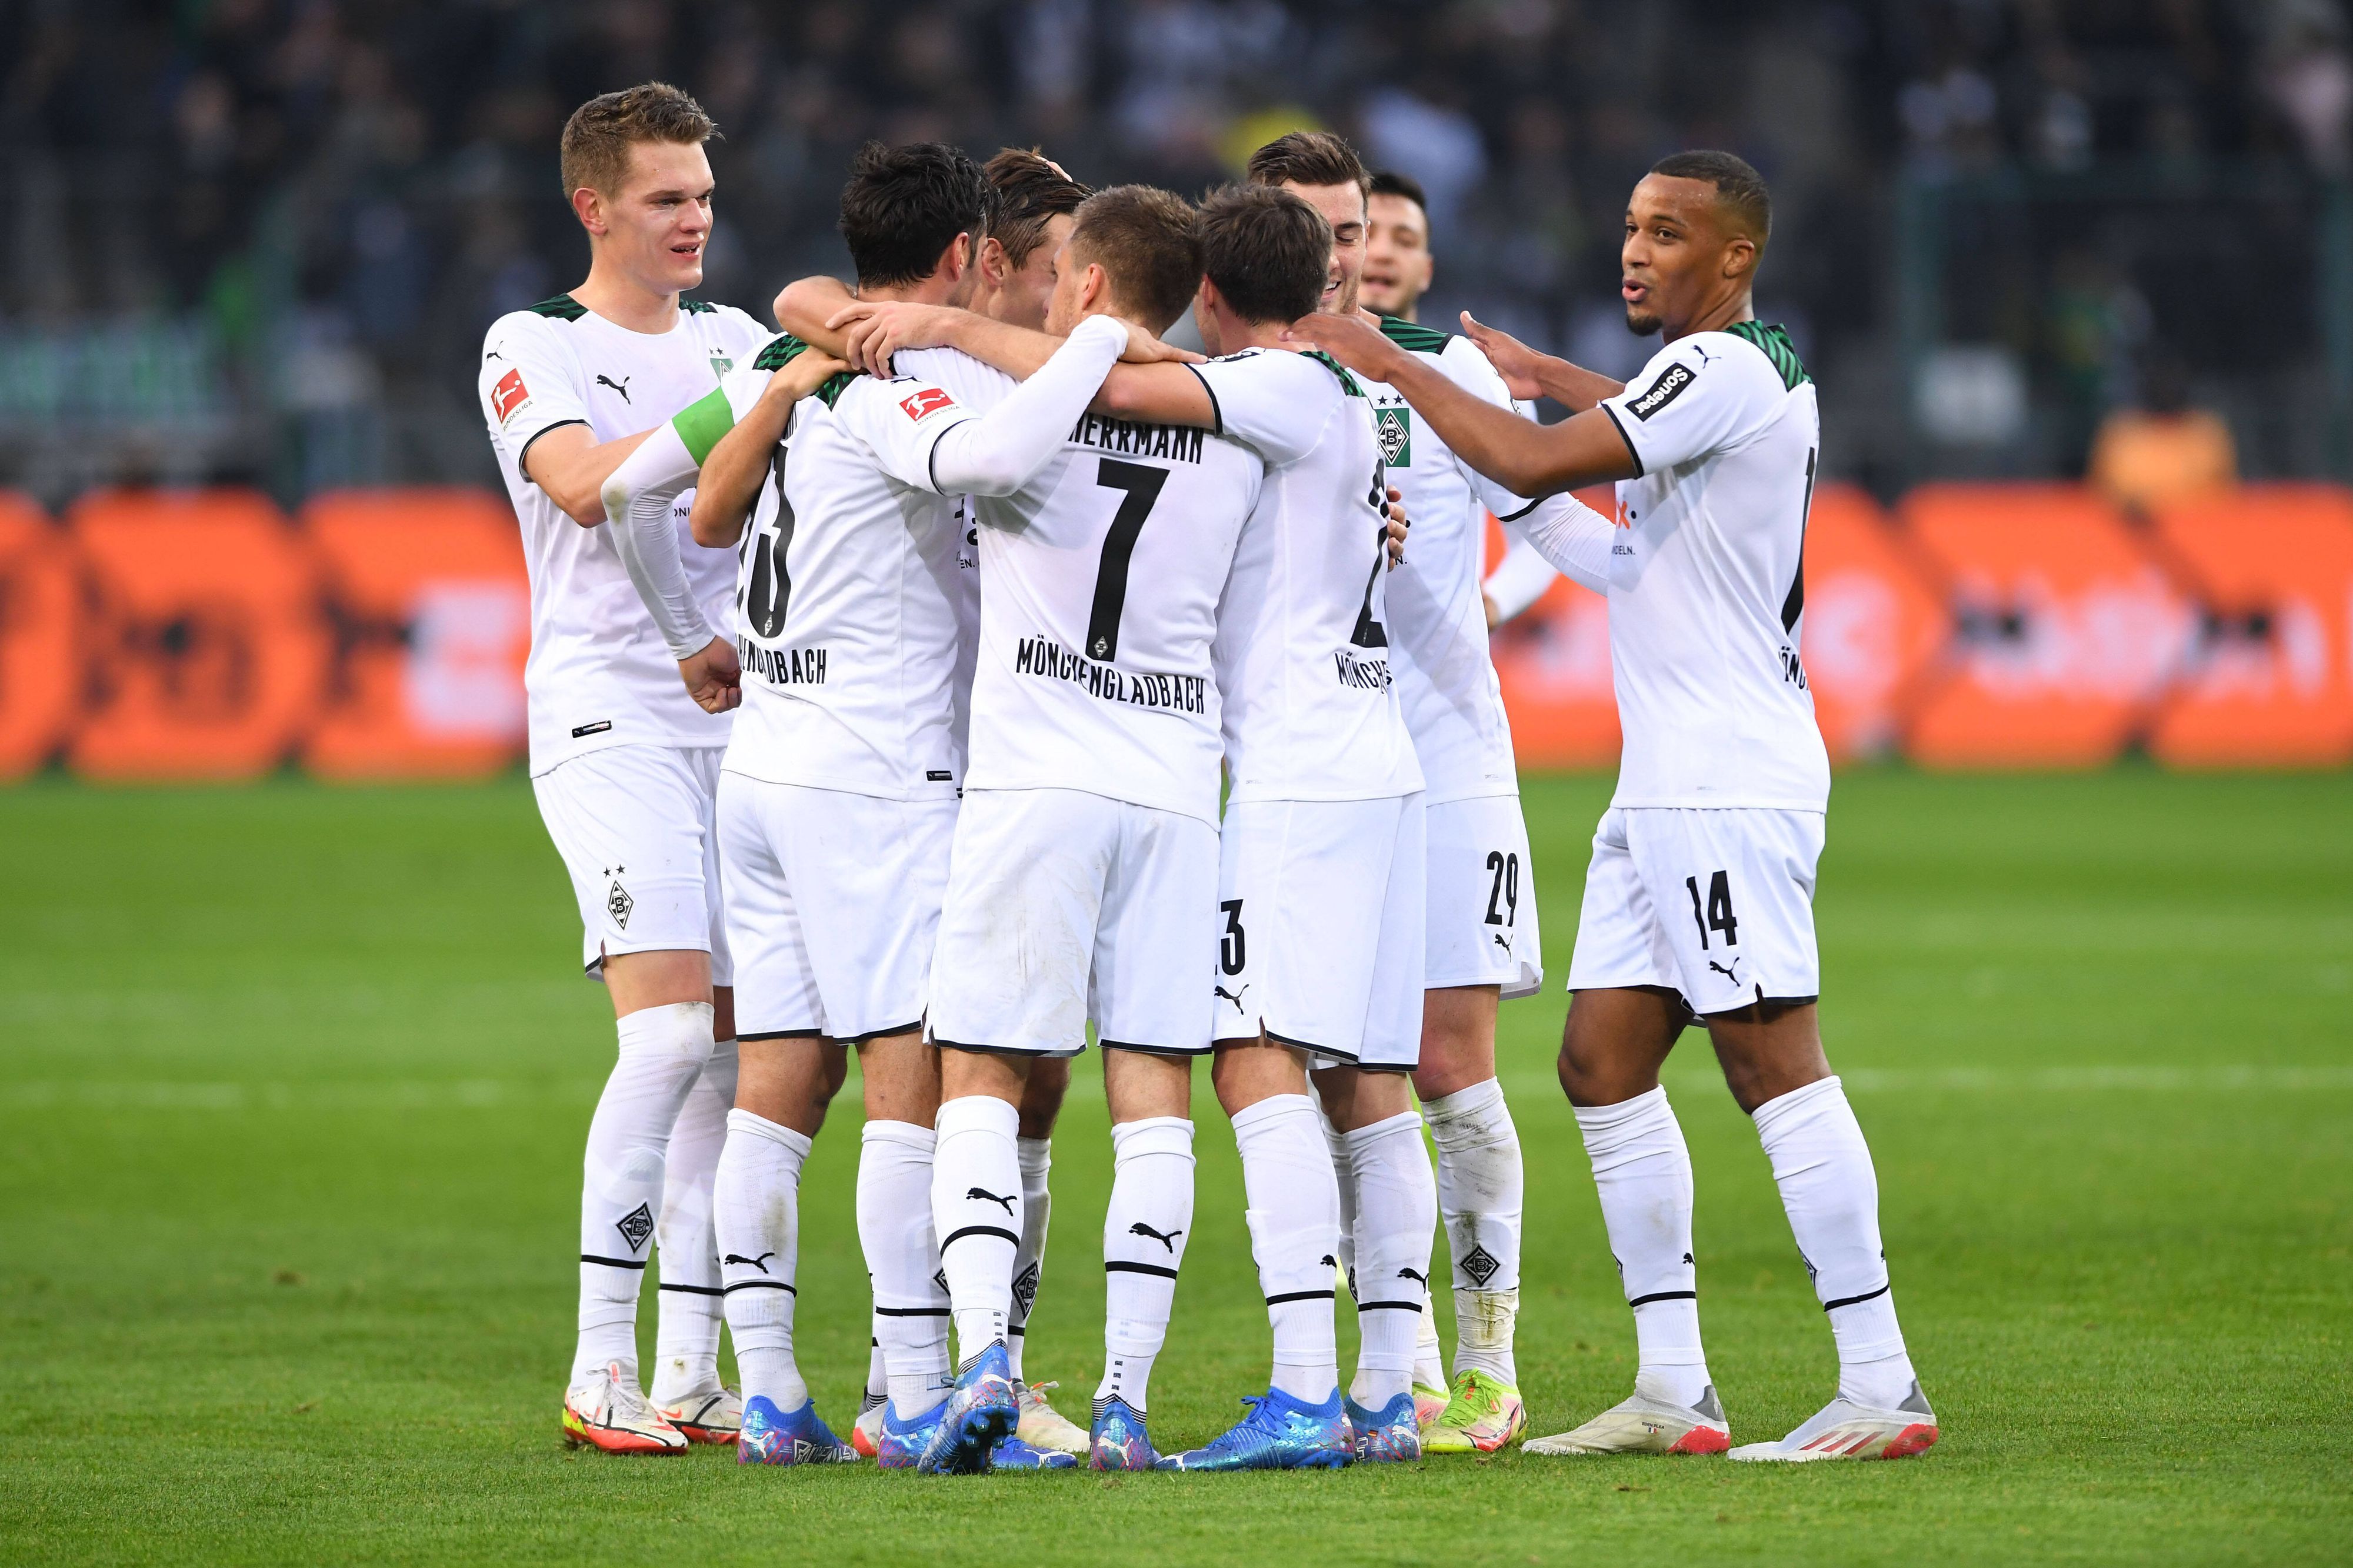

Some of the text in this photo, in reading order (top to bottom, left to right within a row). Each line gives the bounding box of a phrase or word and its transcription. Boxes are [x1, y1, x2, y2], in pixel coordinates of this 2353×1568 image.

[503, 401, 533, 432] BUNDESLIGA
[1635, 368, 1688, 414] Sonepar
[1085, 457, 1171, 662] 7
[1484, 850, 1518, 928] 29
[1687, 870, 1738, 950] 14
[1215, 899, 1245, 976] 3
